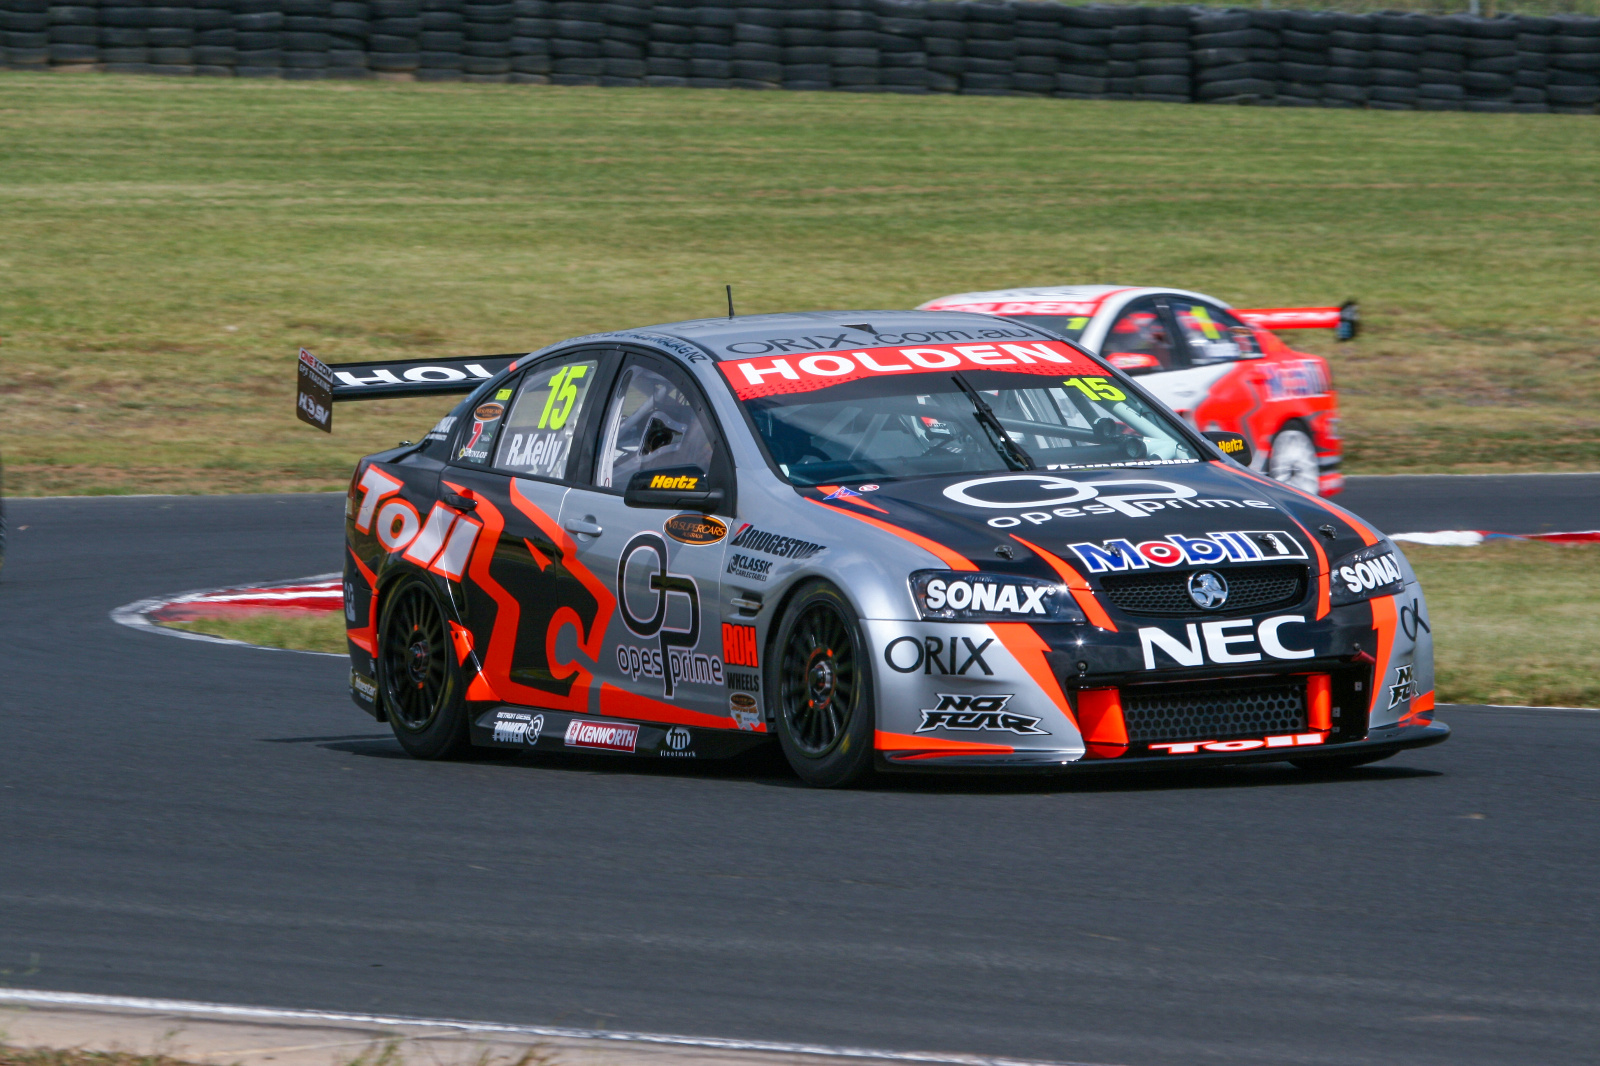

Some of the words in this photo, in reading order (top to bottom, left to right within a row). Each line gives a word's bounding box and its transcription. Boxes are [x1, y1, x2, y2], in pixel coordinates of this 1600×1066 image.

[1066, 317, 1089, 330] 1
[726, 329, 1033, 354] ORIX.com.au
[685, 351, 708, 364] NZ
[738, 343, 1072, 385] HOLDEN
[538, 366, 588, 430] 15
[1064, 378, 1127, 401] 15
[506, 433, 562, 472] R.Kelly
[1218, 439, 1244, 454] Hertz
[650, 475, 698, 489] Hertz
[356, 465, 483, 581] Toll
[987, 503, 1115, 528] opes
[1132, 498, 1277, 513] prime
[677, 521, 727, 537] SUPERCARS
[730, 524, 827, 560] BRIDGESTONE
[1067, 532, 1263, 573] Mobil
[735, 568, 768, 582] CARLECTABLES
[738, 555, 773, 575] CLASSIC
[926, 579, 1047, 614] SONAX
[722, 622, 758, 667] ROH
[1138, 615, 1315, 669] NEC
[617, 644, 663, 681] opes
[669, 649, 724, 687] prime
[884, 636, 995, 676] ORIX
[727, 672, 759, 692] WHEELS
[935, 693, 1015, 711] NO
[913, 709, 1052, 735] FEAR
[578, 725, 635, 747] KENWORTH
[669, 726, 688, 749] fm
[1149, 732, 1328, 754] Toll
